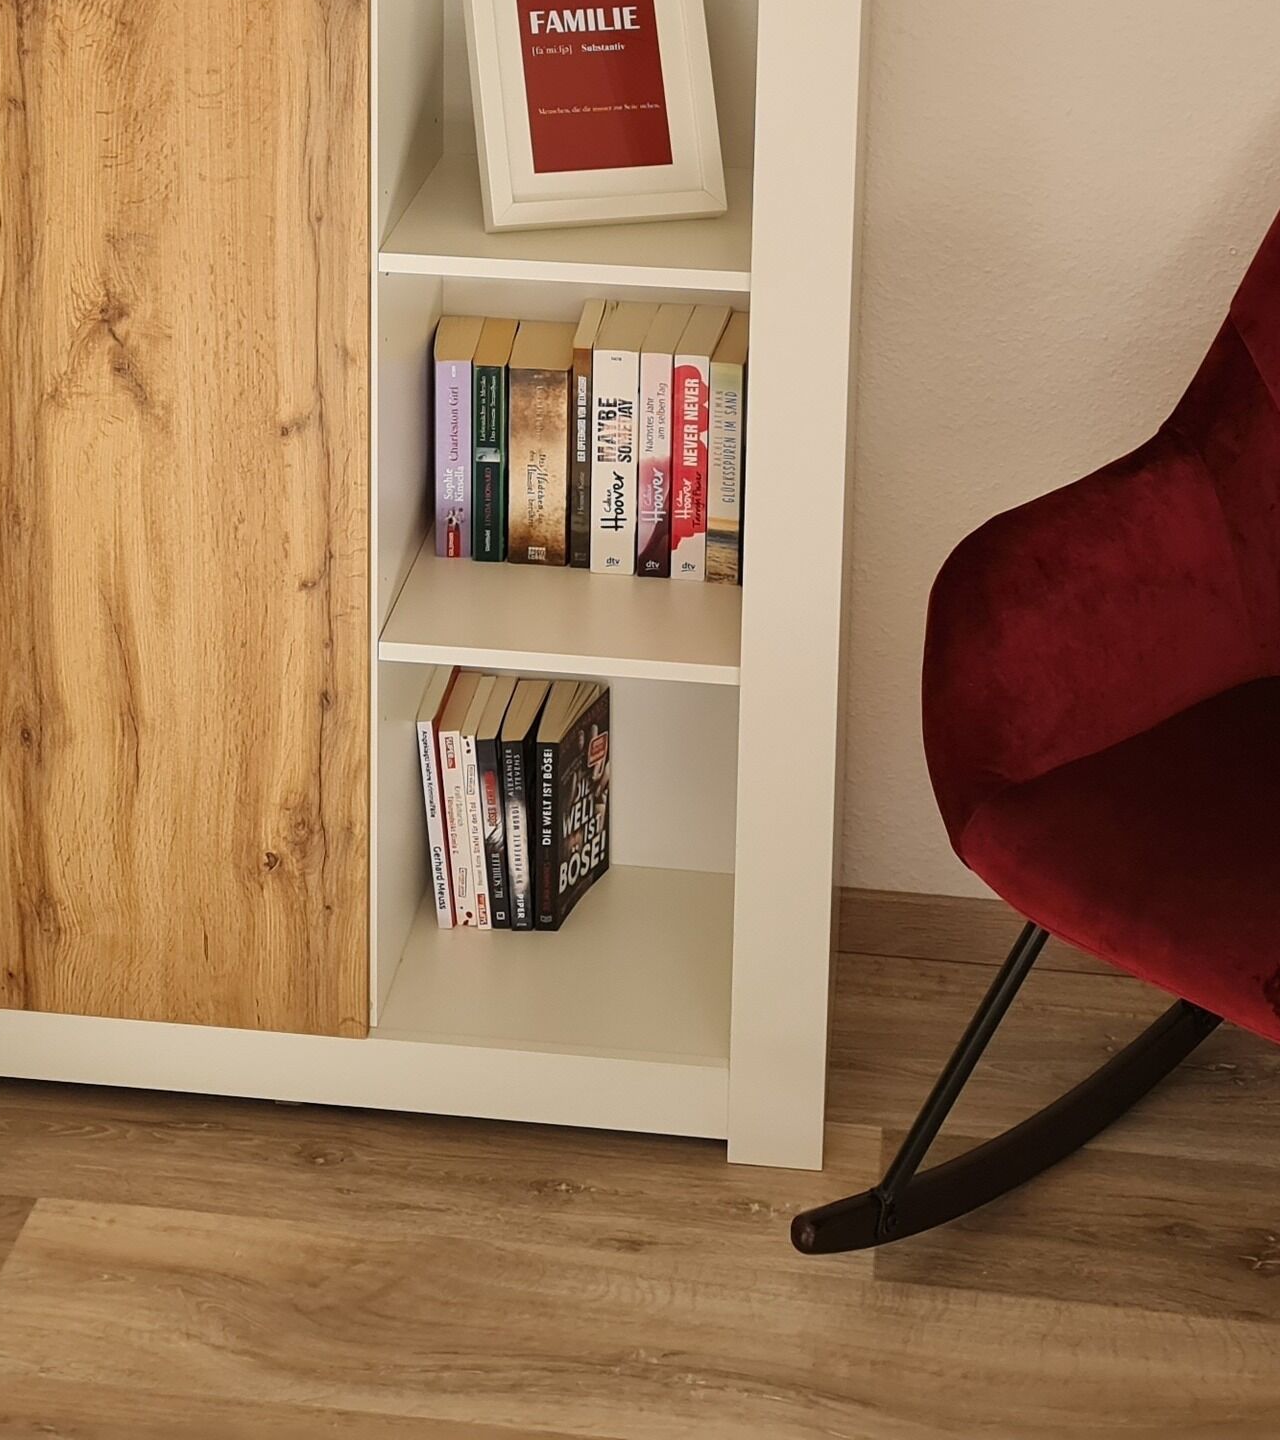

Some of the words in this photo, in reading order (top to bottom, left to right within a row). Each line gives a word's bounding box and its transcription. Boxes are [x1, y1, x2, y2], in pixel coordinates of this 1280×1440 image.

[530, 6, 640, 34] FAMILIE
[581, 42, 625, 52] Substantiv
[448, 386, 458, 406] Girl
[656, 382, 668, 396] Tag
[684, 378, 699, 421] NEVER
[723, 391, 738, 415] SAND
[646, 397, 655, 414] Jahr
[656, 399, 666, 424] selben
[448, 409, 458, 462] Charleston
[597, 397, 617, 463] MAYBE
[617, 398, 633, 463] SOMEDAY
[644, 416, 654, 452] Nächstes
[658, 426, 665, 440] am
[724, 421, 736, 432] IM
[683, 424, 698, 466] NEVER
[713, 436, 722, 467] RACHEL
[443, 468, 454, 500] Sophie
[455, 465, 465, 502] Kinsella
[722, 437, 737, 503] GLÜCKSSPUREN
[600, 470, 628, 531] Hoover
[641, 467, 666, 523] Hoover
[674, 476, 693, 519] Hoover
[645, 560, 660, 568] dtv
[681, 562, 696, 570] dtv
[425, 763, 433, 781] Wahre
[505, 749, 514, 797] ALEXANDER
[513, 753, 521, 791] STEVENS
[541, 749, 553, 779] BÖSE!
[542, 781, 552, 797] IST
[542, 801, 552, 826] WELT
[562, 796, 595, 839] WELT
[542, 828, 552, 845] DIE
[584, 815, 602, 844] IST
[433, 847, 444, 881] Gerhard
[491, 853, 503, 887] SCHILLER
[559, 830, 606, 895] BÖSE!
[437, 882, 446, 910] Meuss
[517, 894, 525, 918] PIPER
